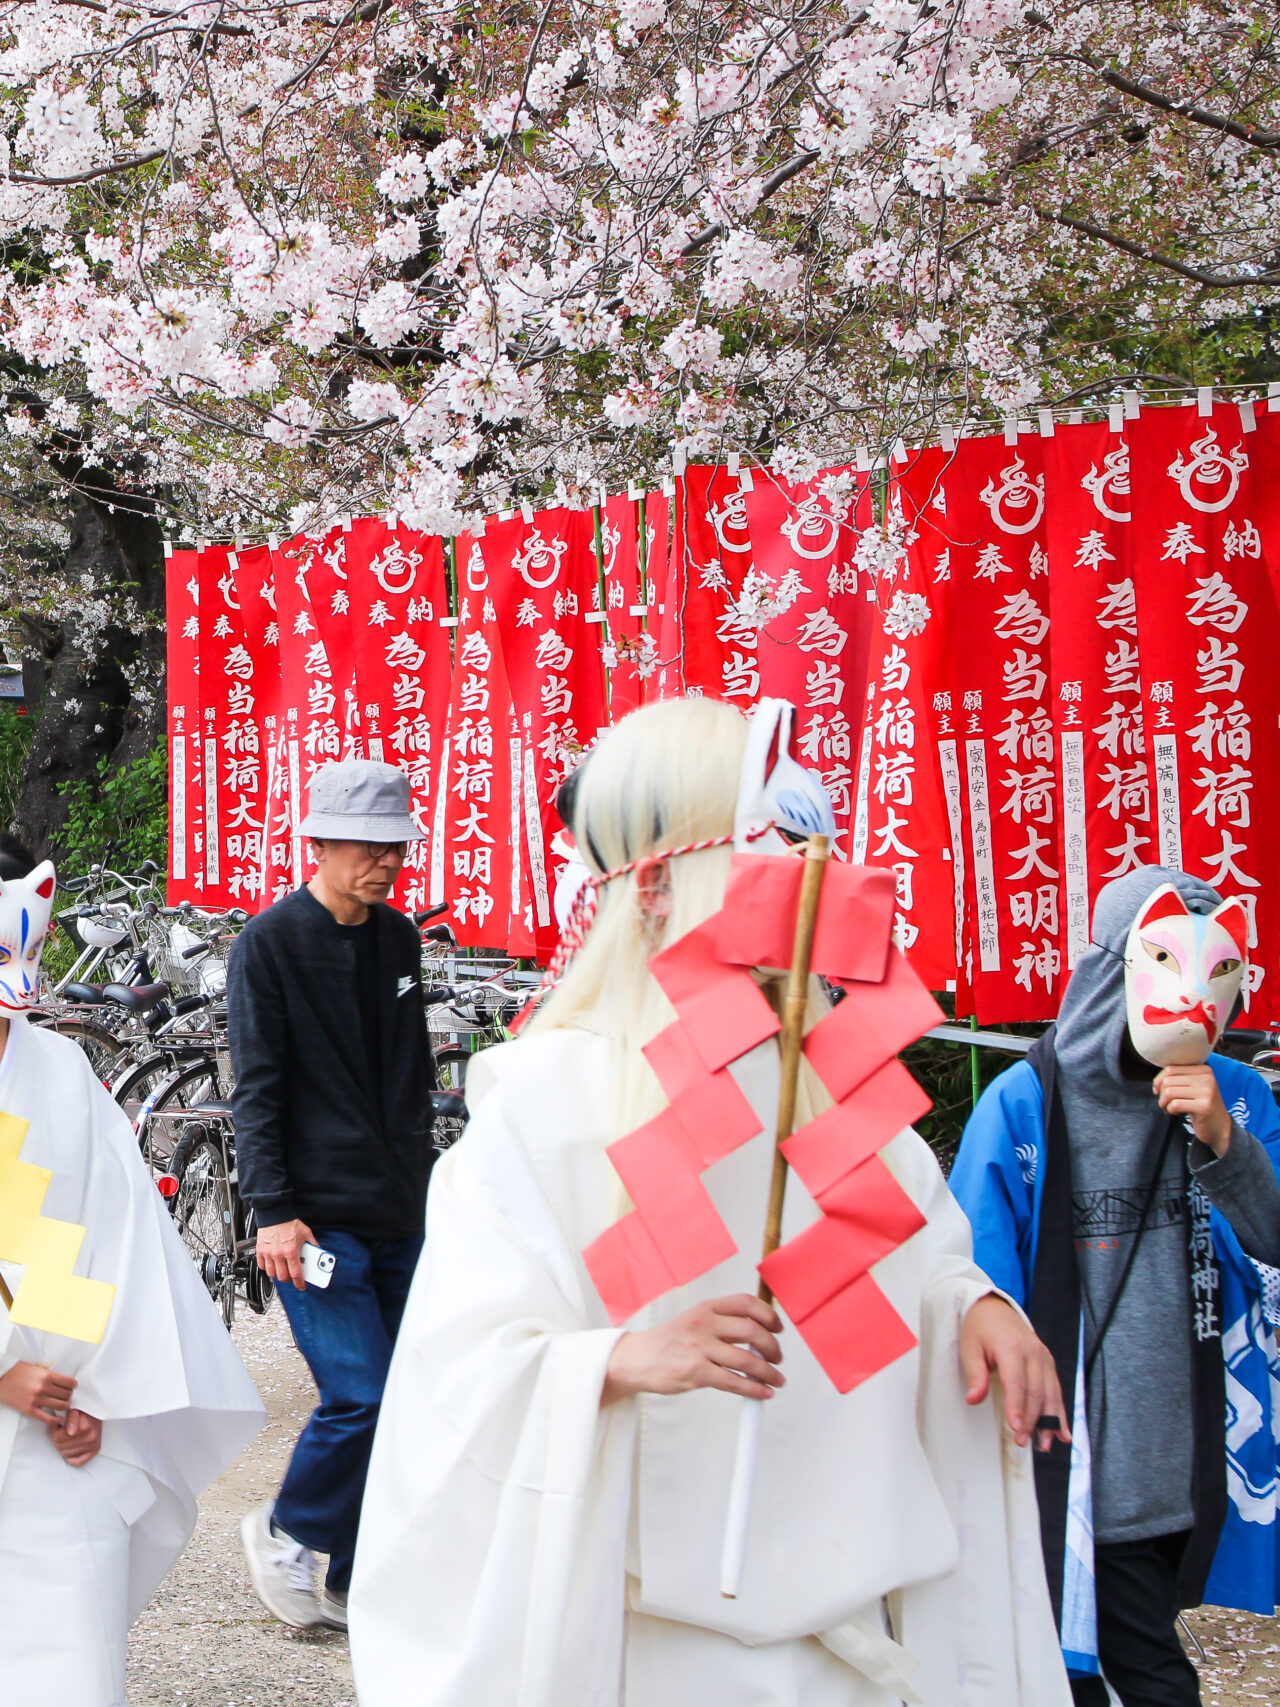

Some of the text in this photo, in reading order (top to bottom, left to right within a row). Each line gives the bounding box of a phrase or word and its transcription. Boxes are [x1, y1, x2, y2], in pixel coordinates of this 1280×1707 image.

[220, 643, 265, 902] 為当稲荷大明神
[451, 630, 494, 929] 為当稲荷大明神
